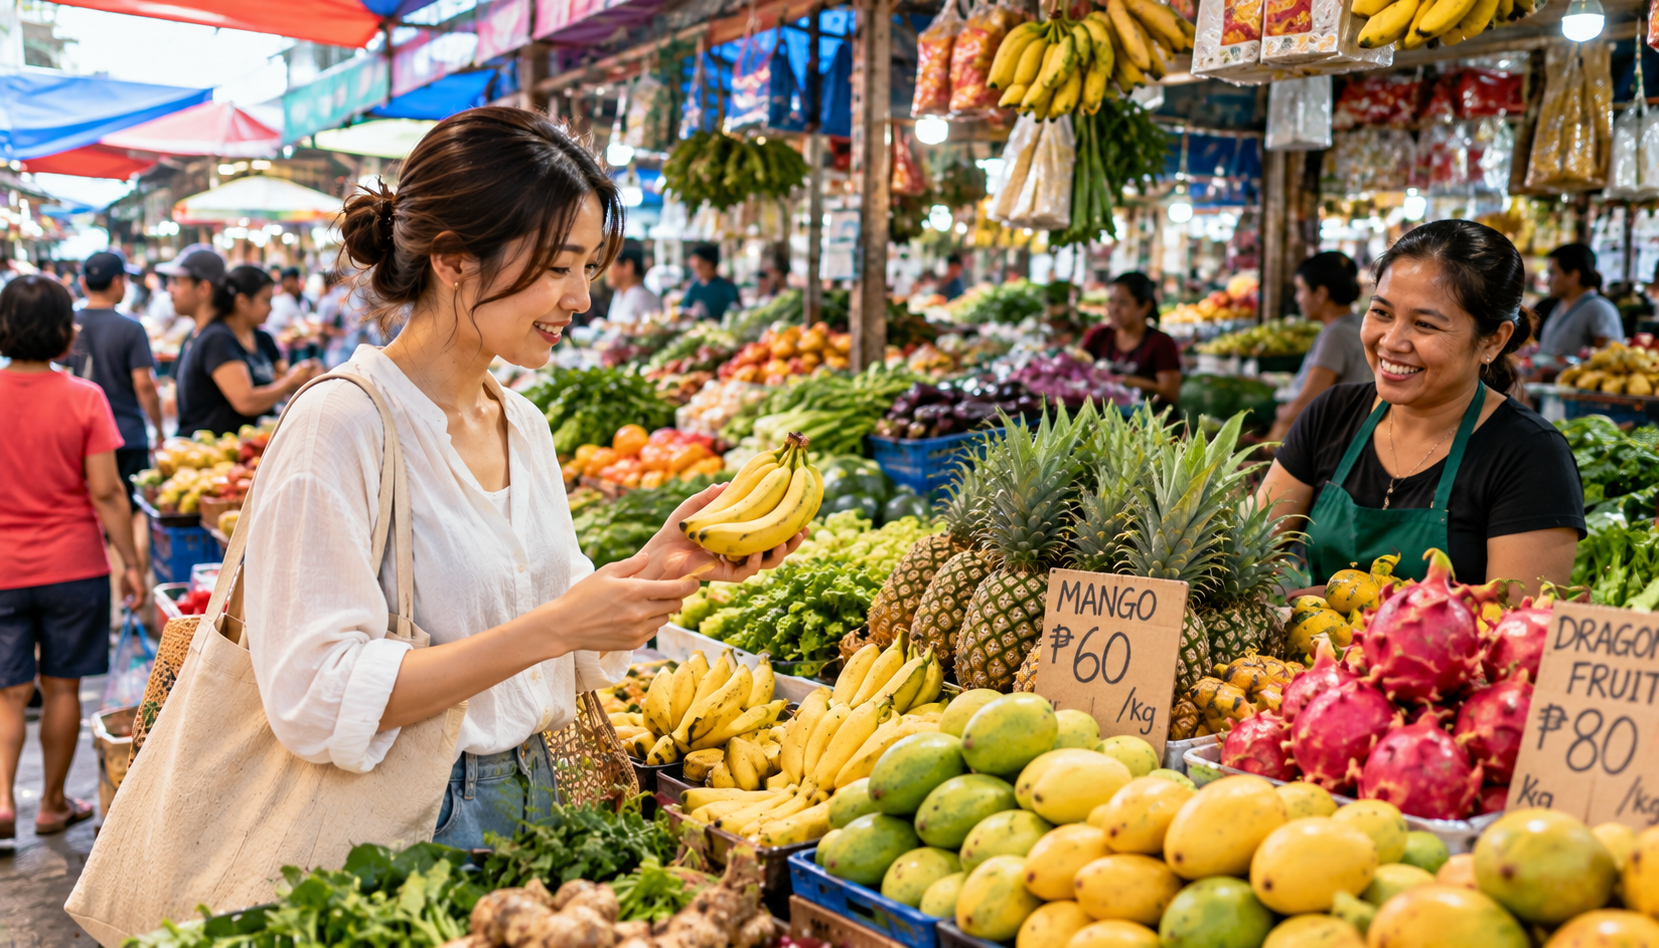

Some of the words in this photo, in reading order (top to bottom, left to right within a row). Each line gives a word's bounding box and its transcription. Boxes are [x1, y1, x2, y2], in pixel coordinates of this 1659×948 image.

[1057, 580, 1157, 621] MANGO
[1049, 624, 1131, 684] ₱60
[1566, 662, 1659, 705] FRUIT
[1116, 687, 1156, 735] /kg
[1537, 703, 1638, 775] ₱80
